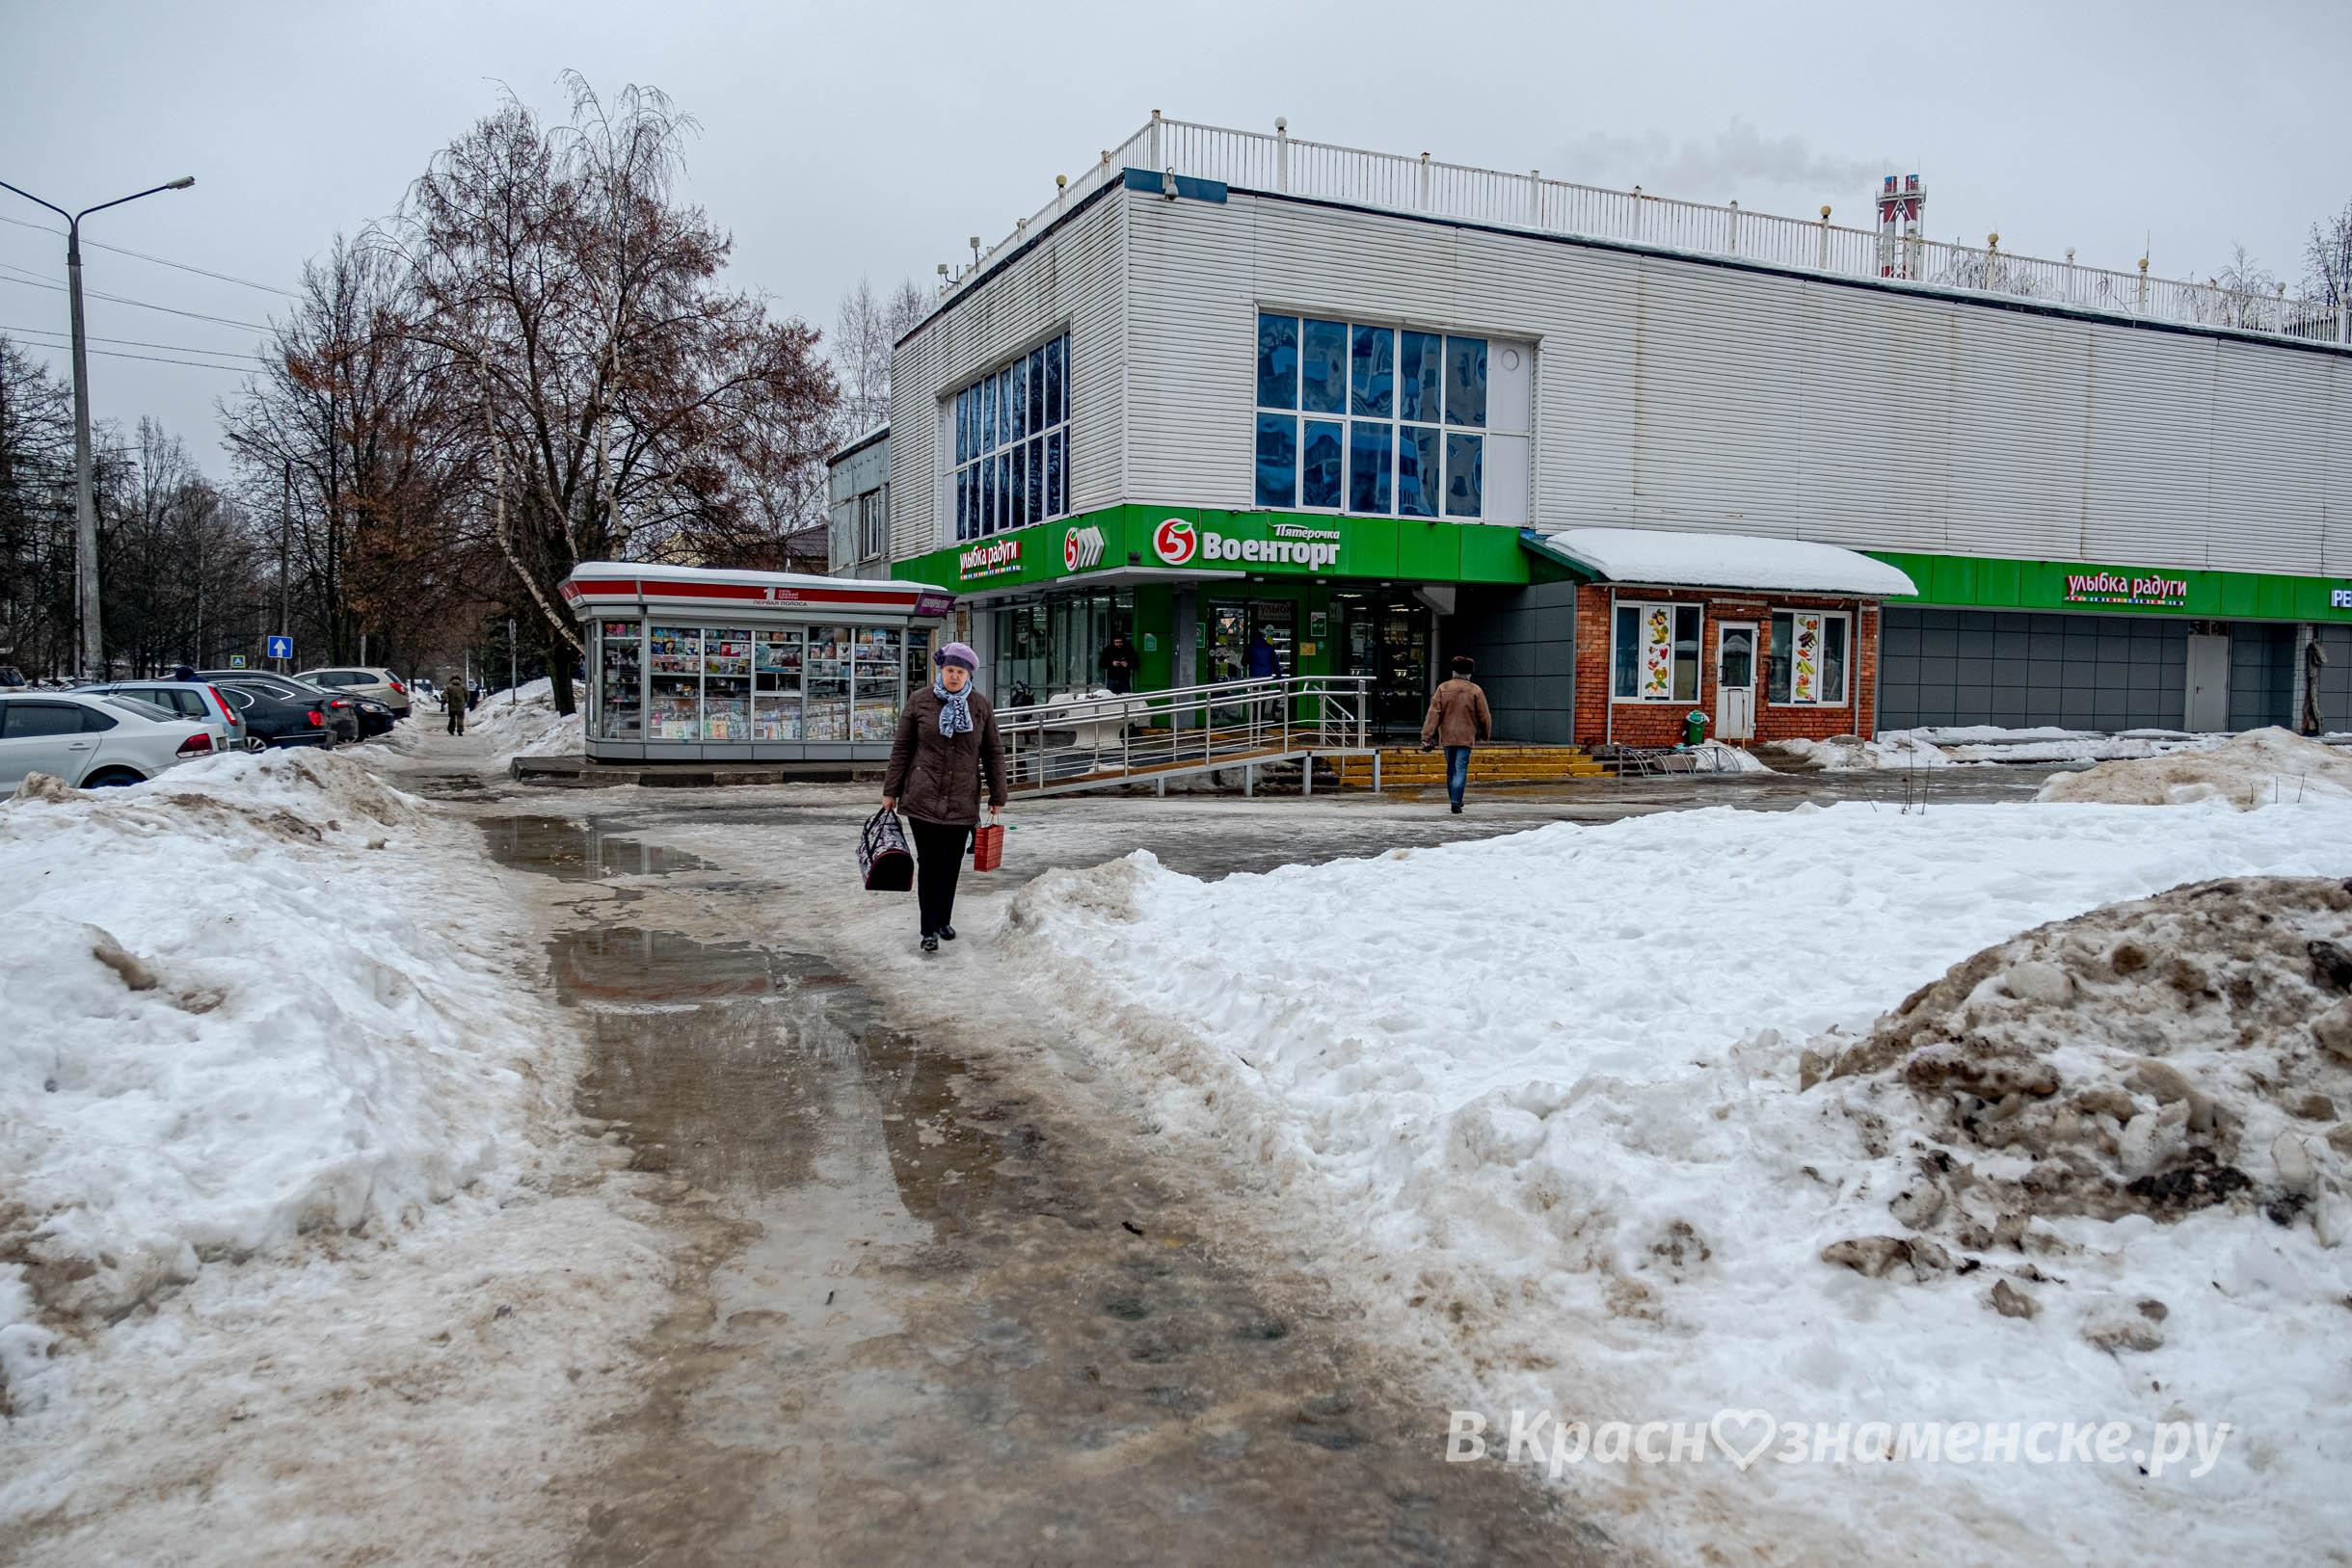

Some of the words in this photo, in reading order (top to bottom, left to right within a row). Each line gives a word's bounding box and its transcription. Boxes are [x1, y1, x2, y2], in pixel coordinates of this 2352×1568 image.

[1272, 524, 1341, 541] Пятерочка
[959, 545, 988, 573] улыбка
[988, 540, 1021, 570] радуги
[1202, 532, 1341, 571] Военторг
[2066, 572, 2128, 596] улыбка
[2130, 574, 2187, 599] радуги
